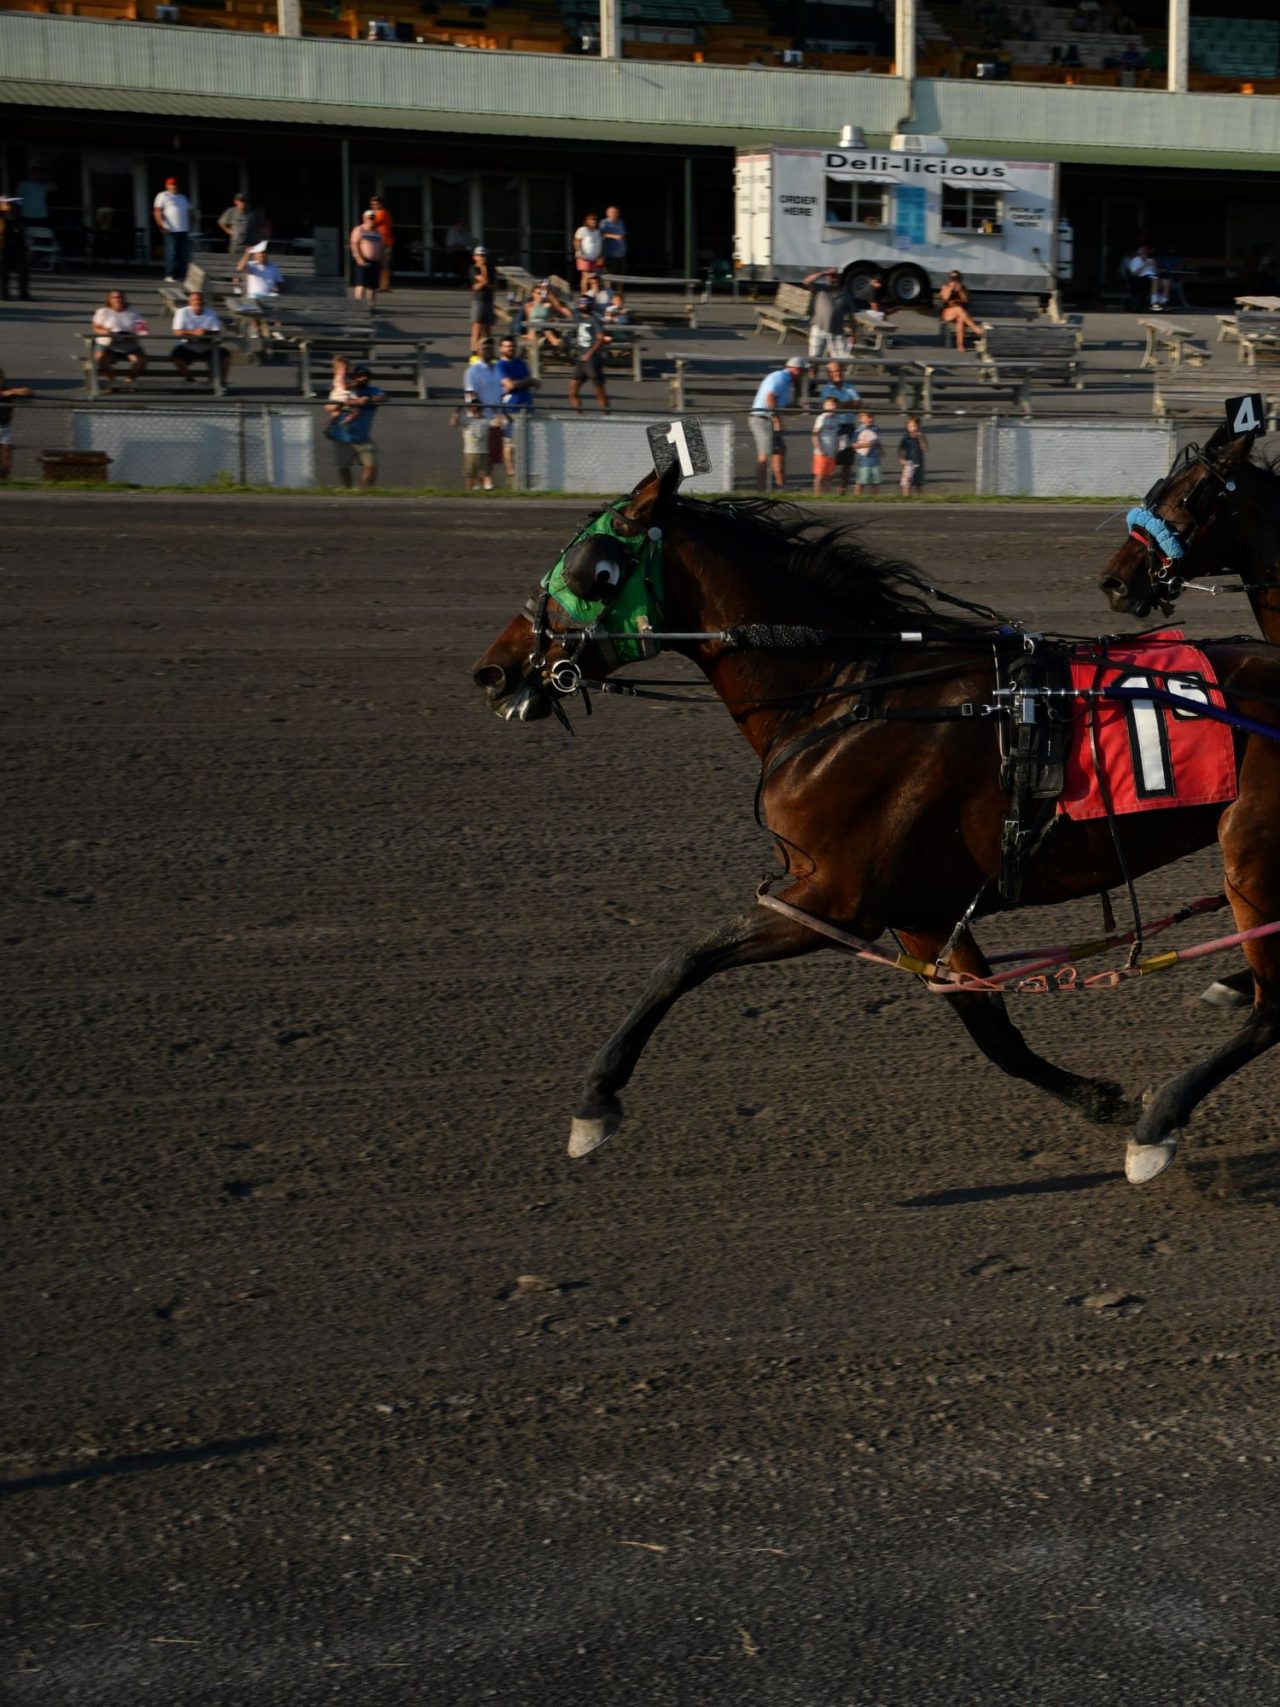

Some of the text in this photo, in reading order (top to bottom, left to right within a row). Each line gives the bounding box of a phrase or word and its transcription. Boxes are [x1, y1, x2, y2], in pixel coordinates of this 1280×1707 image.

[826, 153, 1005, 177] Deli-licious
[779, 195, 817, 205] ORDER
[783, 207, 813, 217] HERE
[1233, 396, 1261, 434] 4
[666, 420, 695, 477] 1
[1117, 674, 1168, 793] 1
